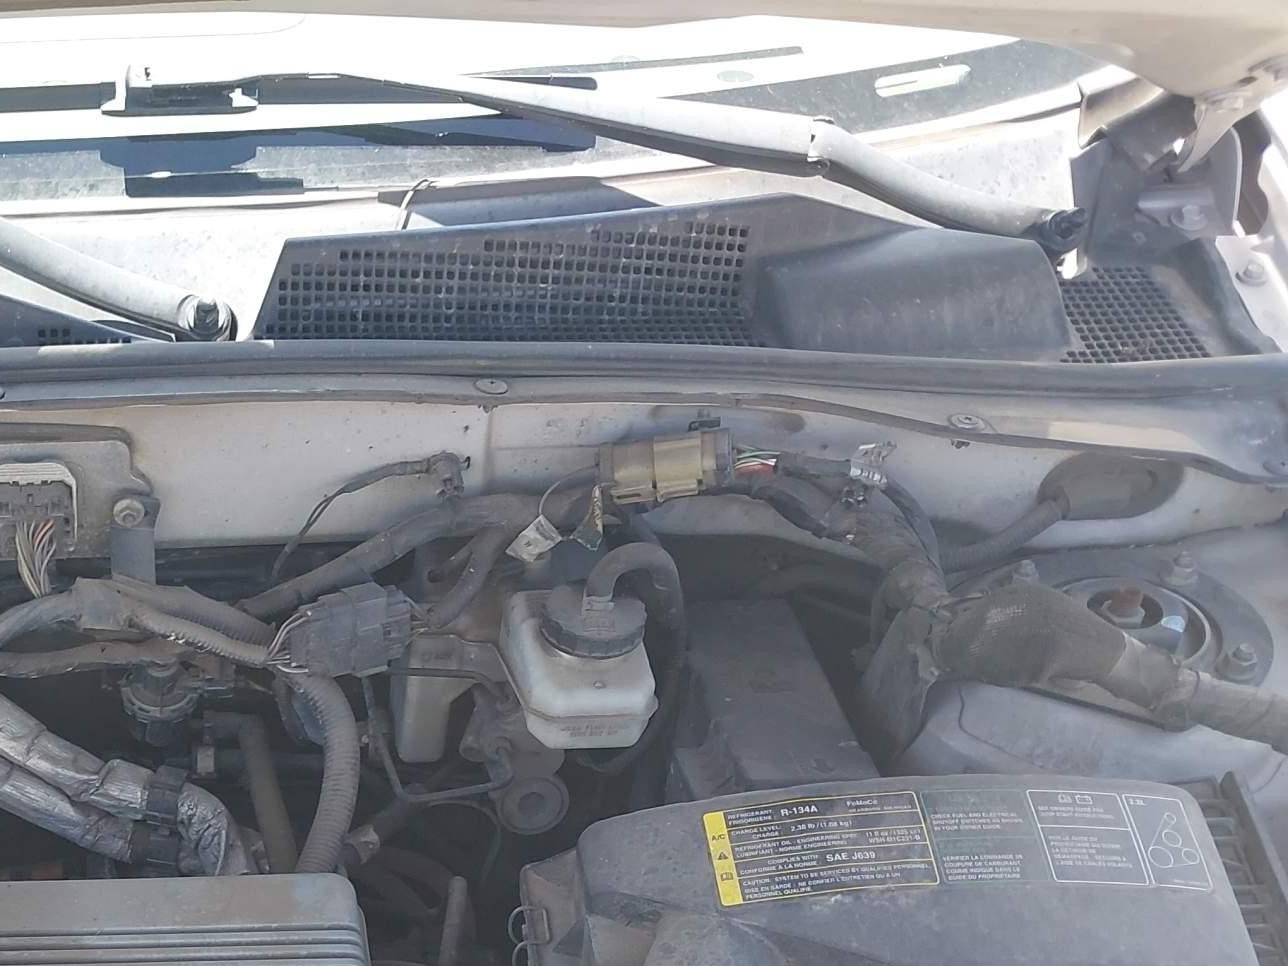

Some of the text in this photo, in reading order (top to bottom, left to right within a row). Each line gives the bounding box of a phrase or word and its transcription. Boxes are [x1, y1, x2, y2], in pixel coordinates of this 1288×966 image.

[780, 804, 818, 816] R-134A
[711, 832, 726, 841] A/C
[826, 851, 876, 862] SAE J639
